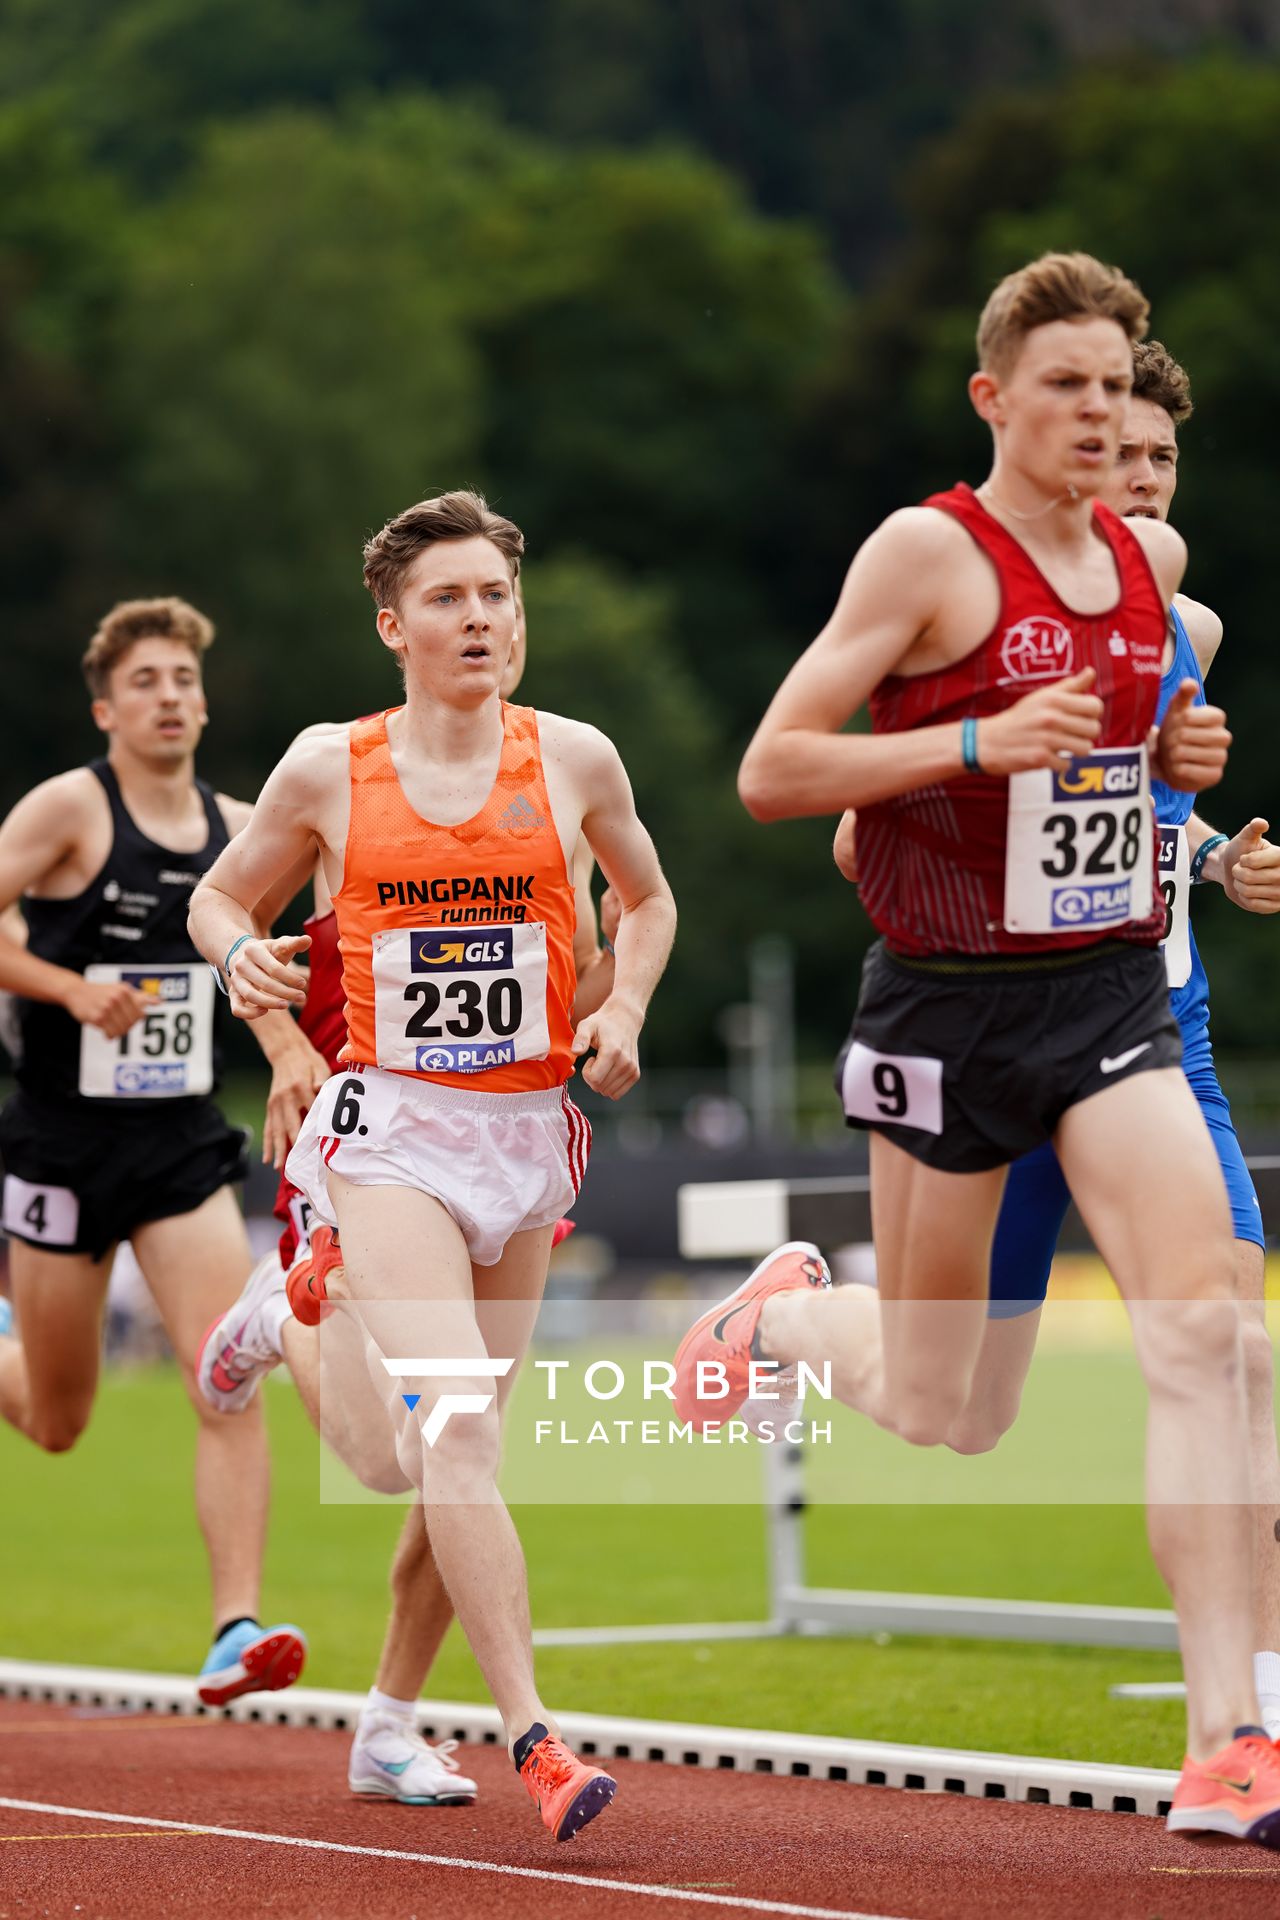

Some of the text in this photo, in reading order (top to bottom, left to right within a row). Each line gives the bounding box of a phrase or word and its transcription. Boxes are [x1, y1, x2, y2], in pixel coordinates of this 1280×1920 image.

[1104, 764, 1139, 792] GLS
[1041, 808, 1141, 878] 328
[1158, 841, 1174, 862] LS
[377, 875, 535, 906] PINGPANK
[441, 903, 527, 923] running
[464, 941, 505, 963] GLS
[403, 978, 523, 1038] 230
[458, 1048, 512, 1066] PLAN
[873, 1063, 907, 1118] 9
[331, 1078, 369, 1136] 6.
[25, 1195, 47, 1233] 4
